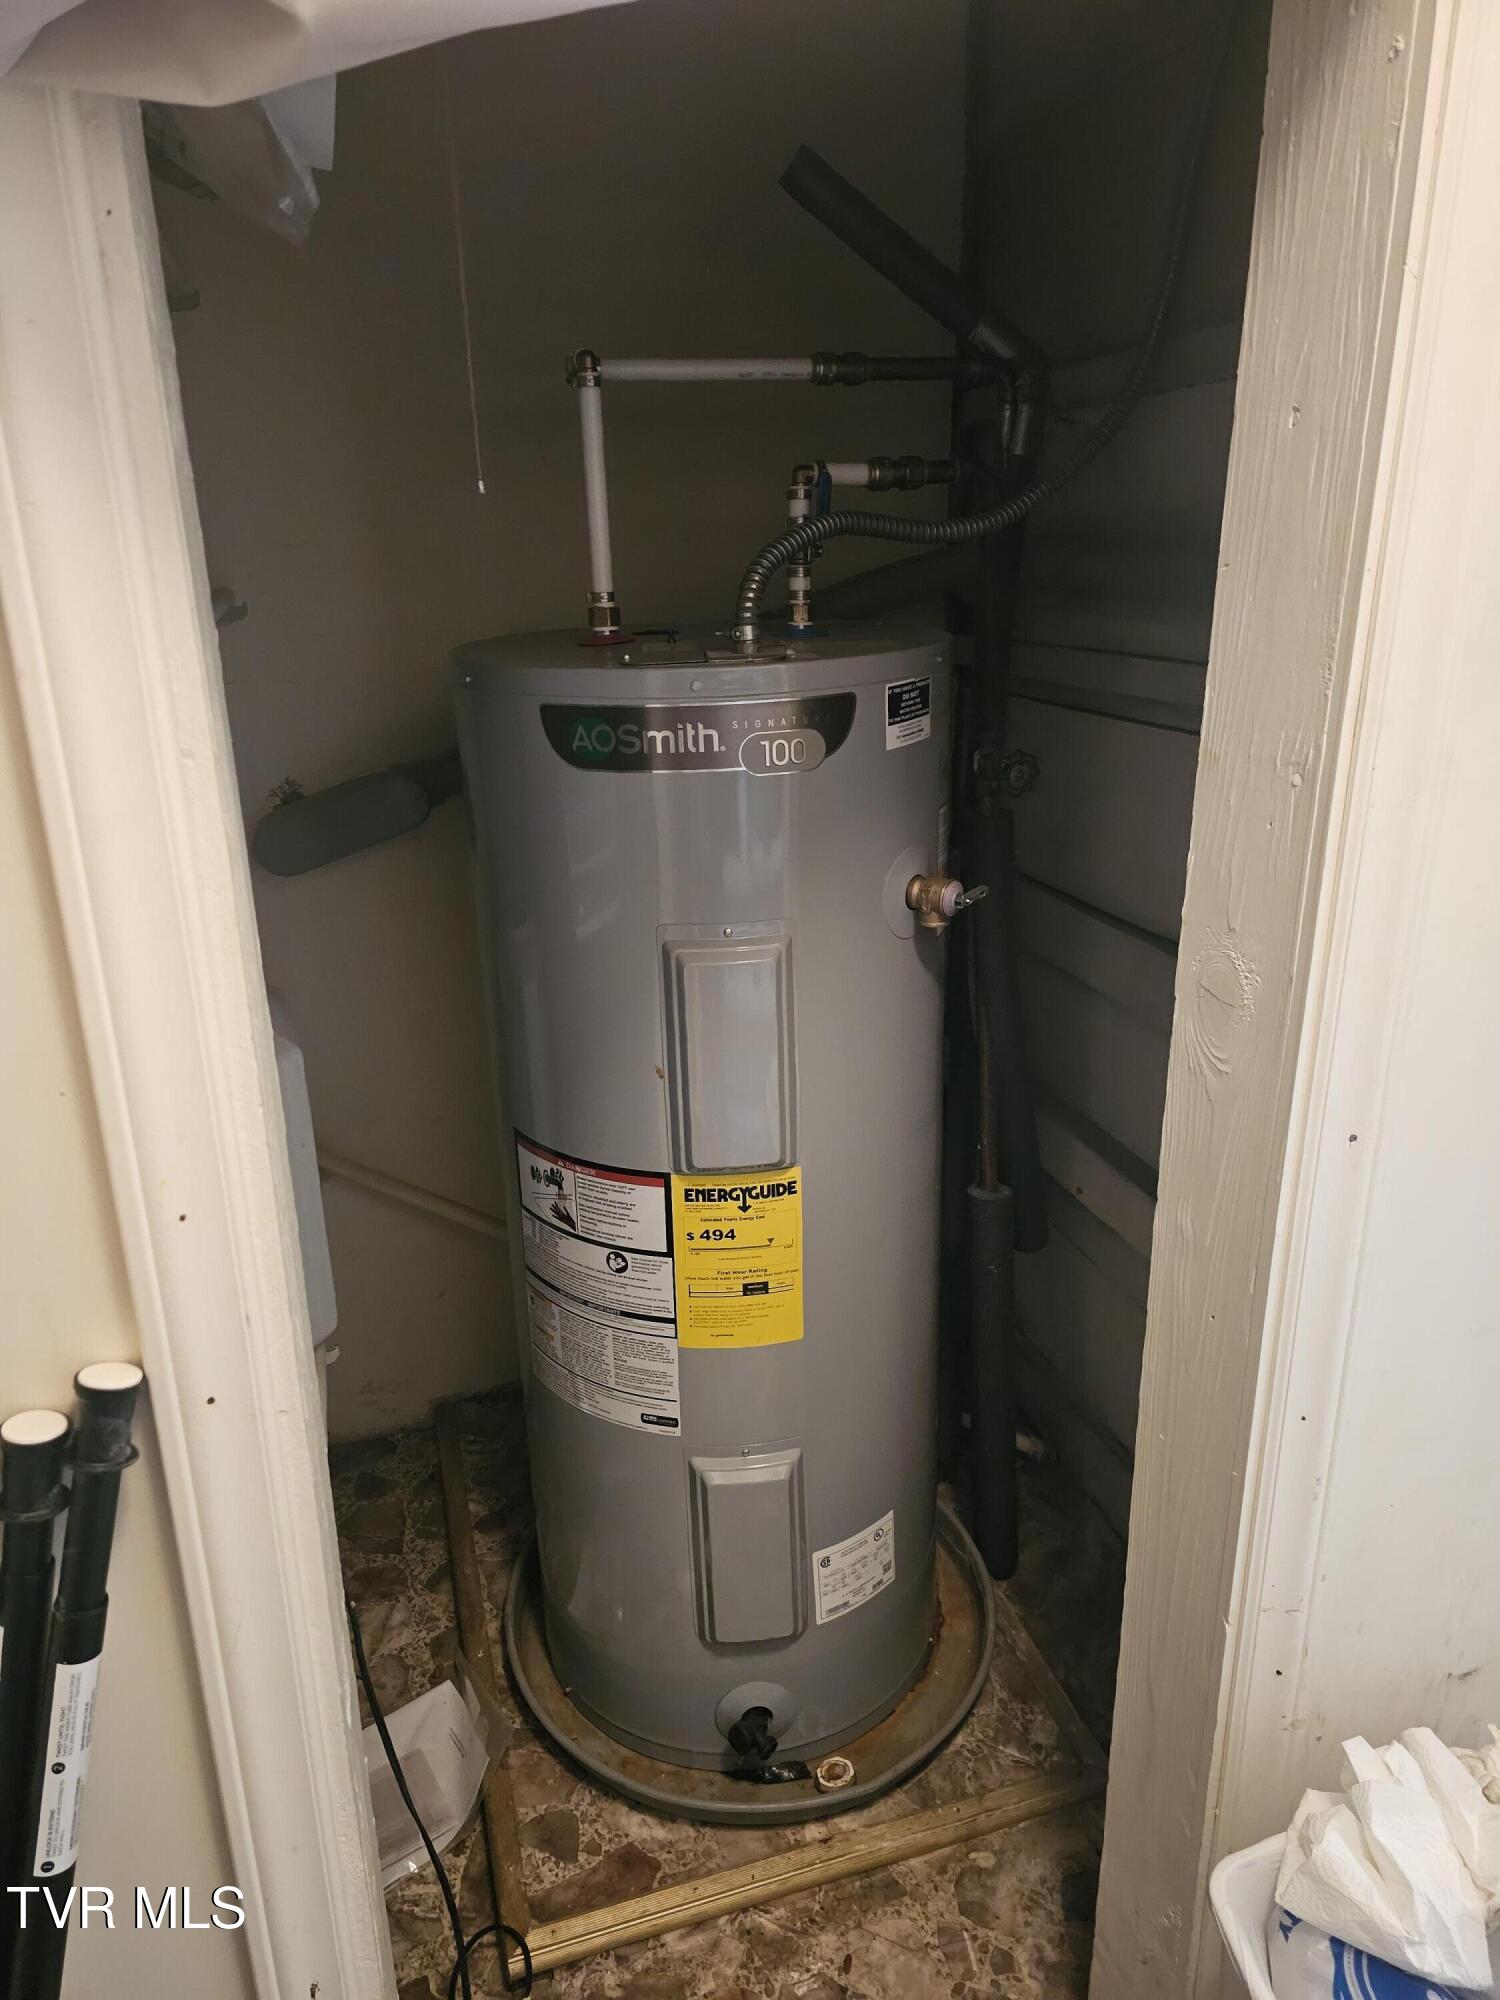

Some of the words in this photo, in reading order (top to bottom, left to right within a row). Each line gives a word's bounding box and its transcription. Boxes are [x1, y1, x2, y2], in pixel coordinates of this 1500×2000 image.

[760, 738, 806, 767] 100
[566, 1161, 596, 1176] DANGER
[684, 1180, 798, 1207] ENERGYGUIDE
[686, 1232, 694, 1241] $
[699, 1228, 737, 1241] 494
